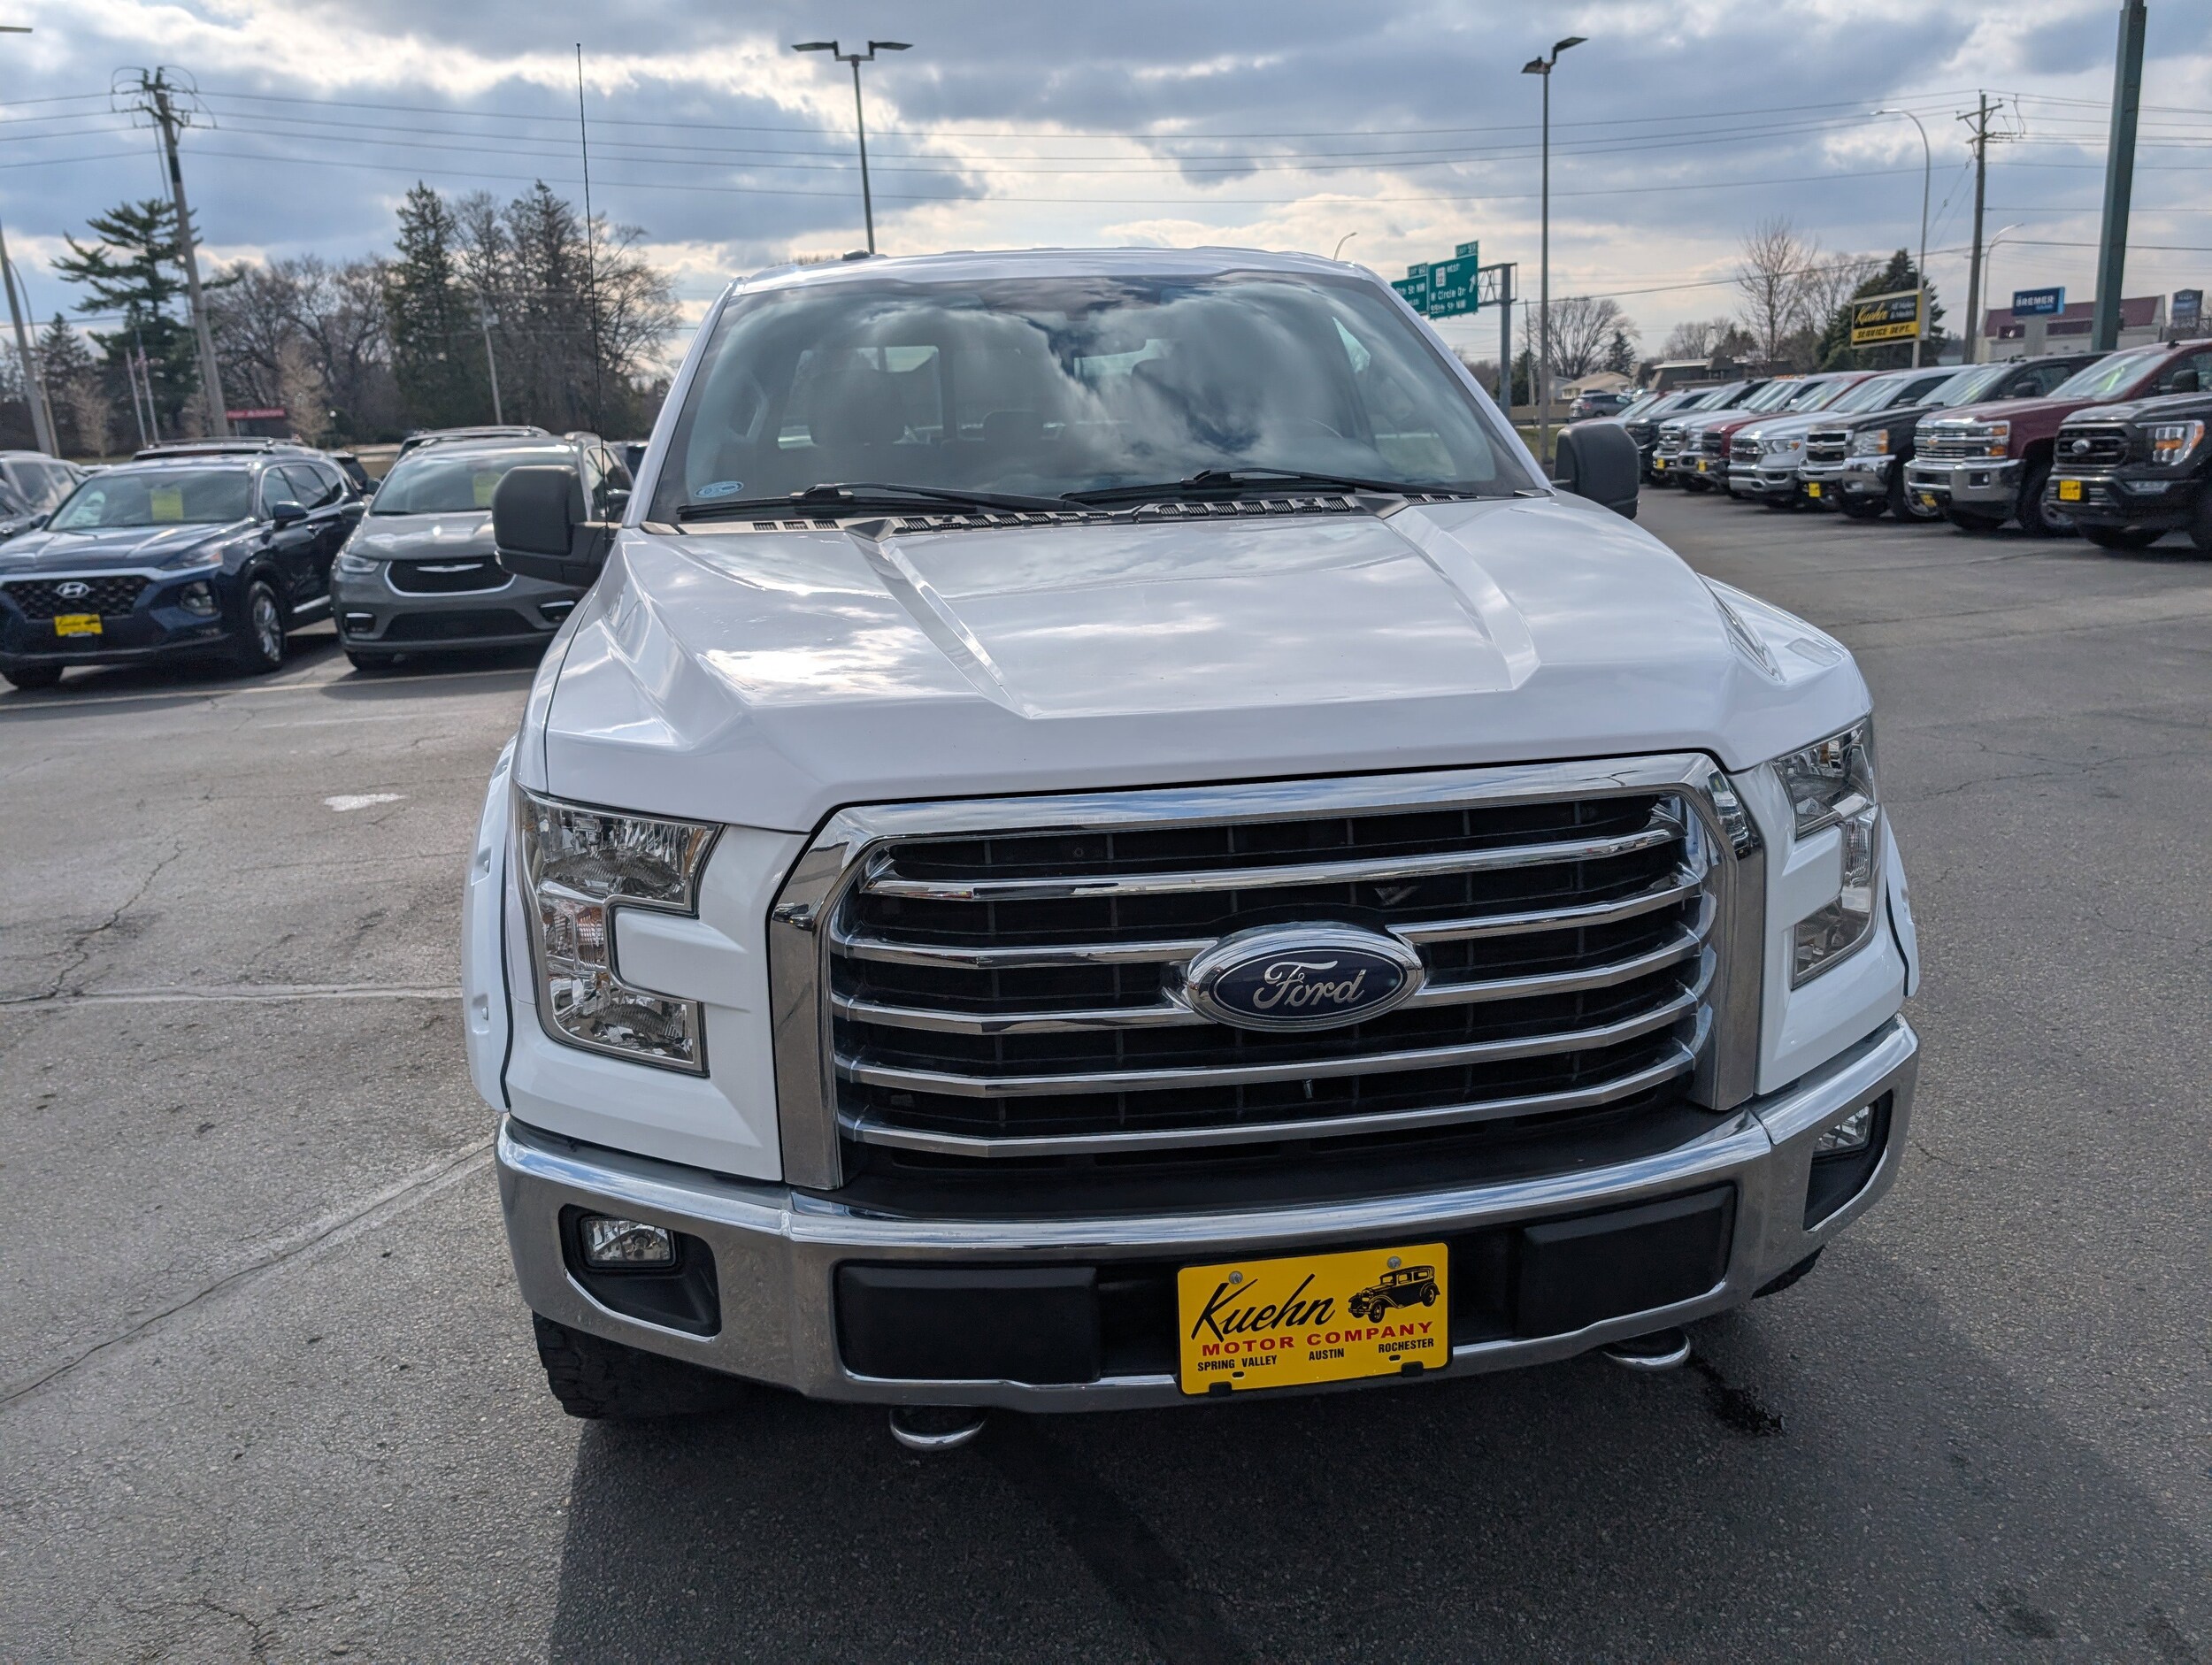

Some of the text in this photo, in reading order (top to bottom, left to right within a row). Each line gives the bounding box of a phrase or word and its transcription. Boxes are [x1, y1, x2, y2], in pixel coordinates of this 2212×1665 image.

[1437, 288, 1456, 301] Circle
[1457, 286, 1466, 296] Dr
[1447, 301, 1455, 311] St
[1455, 299, 1467, 309] NW
[2016, 295, 2055, 307] BREMER
[1855, 302, 1889, 326] Kuehn
[1857, 326, 1887, 339] SERVICE
[1252, 959, 1368, 1009] Ford
[1190, 1272, 1336, 1343] Kuehn
[1202, 1321, 1433, 1357] MOTOR COMPANY
[1197, 1338, 1435, 1372] SPRING VALLEY AUSTIN ROCHESTER
